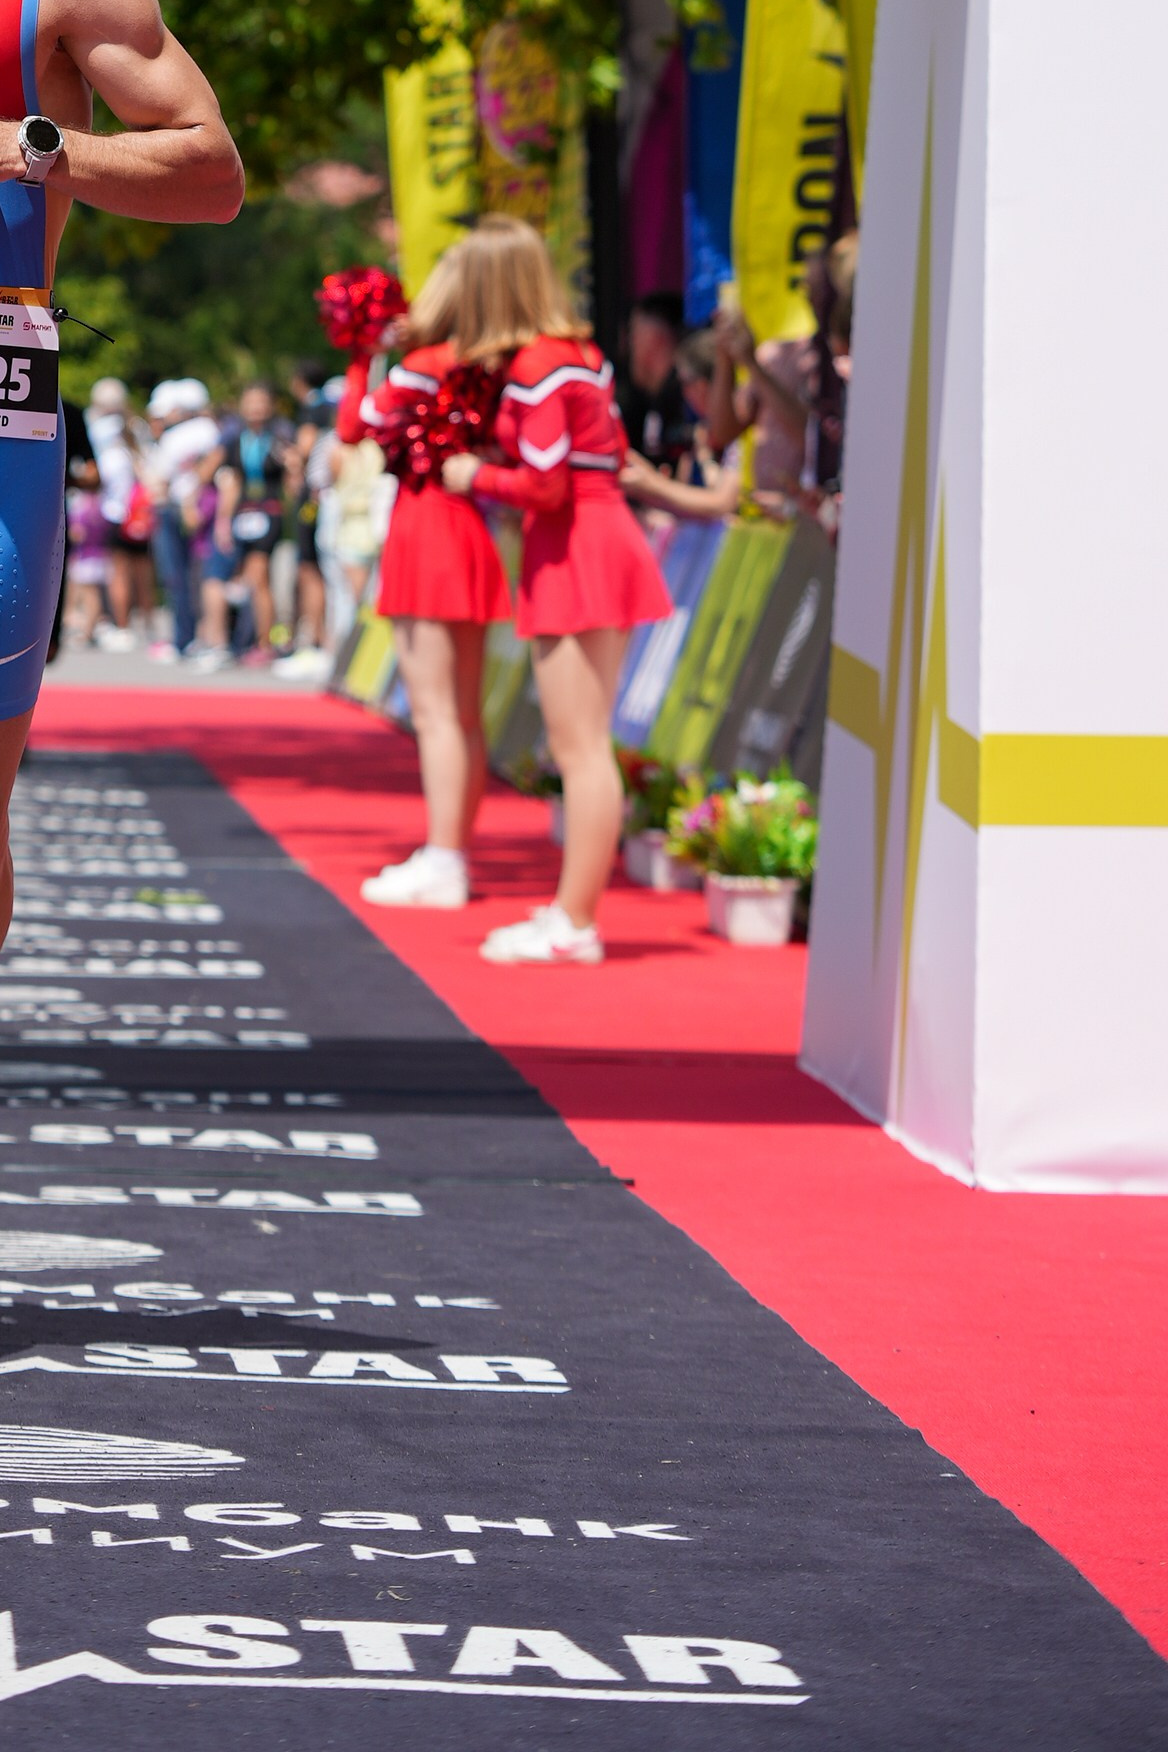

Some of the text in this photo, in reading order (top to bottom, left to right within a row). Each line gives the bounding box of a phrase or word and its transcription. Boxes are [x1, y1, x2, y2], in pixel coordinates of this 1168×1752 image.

[31, 323, 52, 332] МАГНИТ
[84, 1342, 568, 1384] STAR
[146, 1615, 805, 1688] STAR
